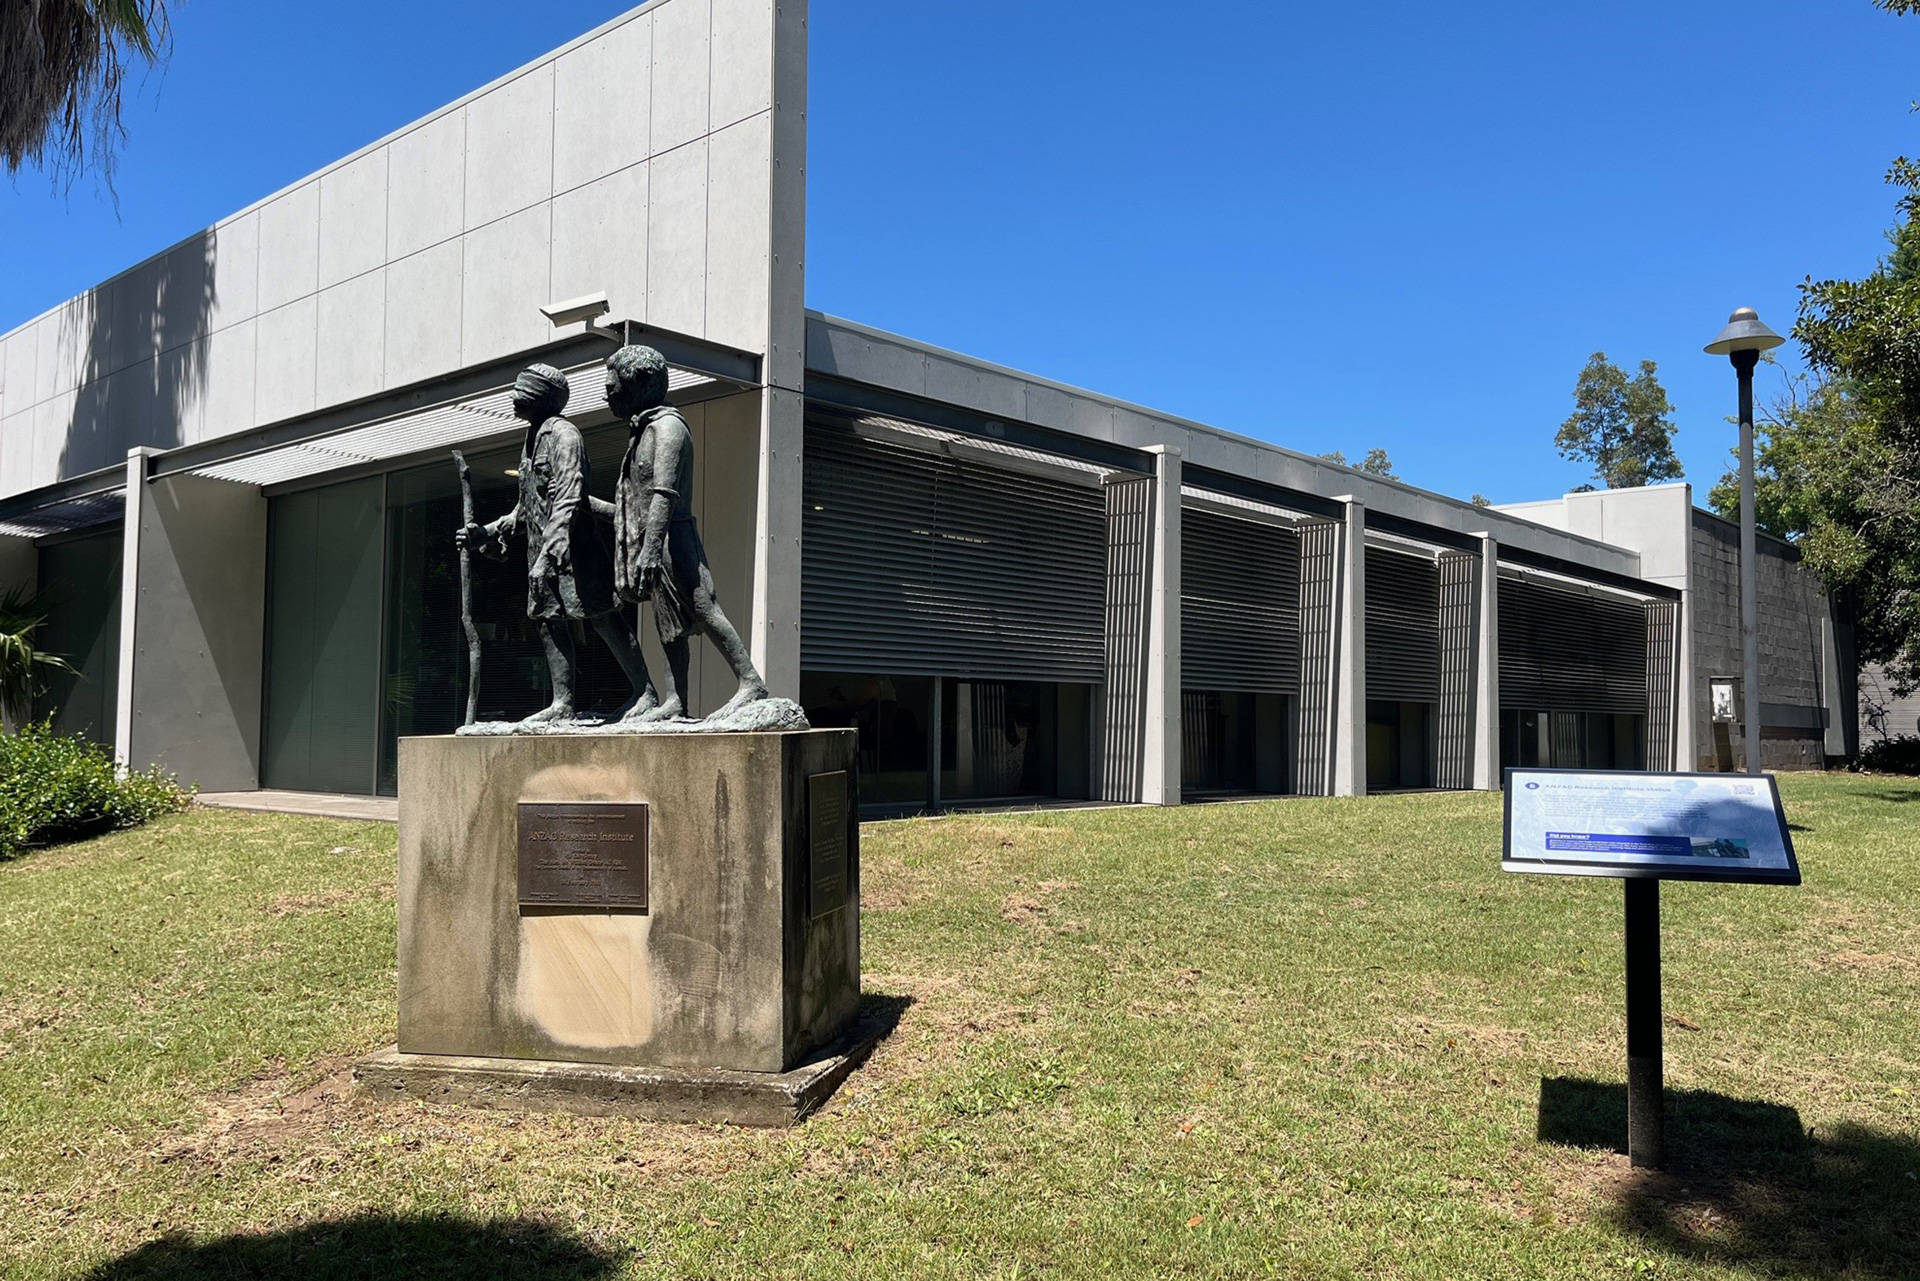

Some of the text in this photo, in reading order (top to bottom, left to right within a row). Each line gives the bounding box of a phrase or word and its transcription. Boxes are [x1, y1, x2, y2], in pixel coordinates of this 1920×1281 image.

[528, 831, 634, 842] ANZAC Research Institute
